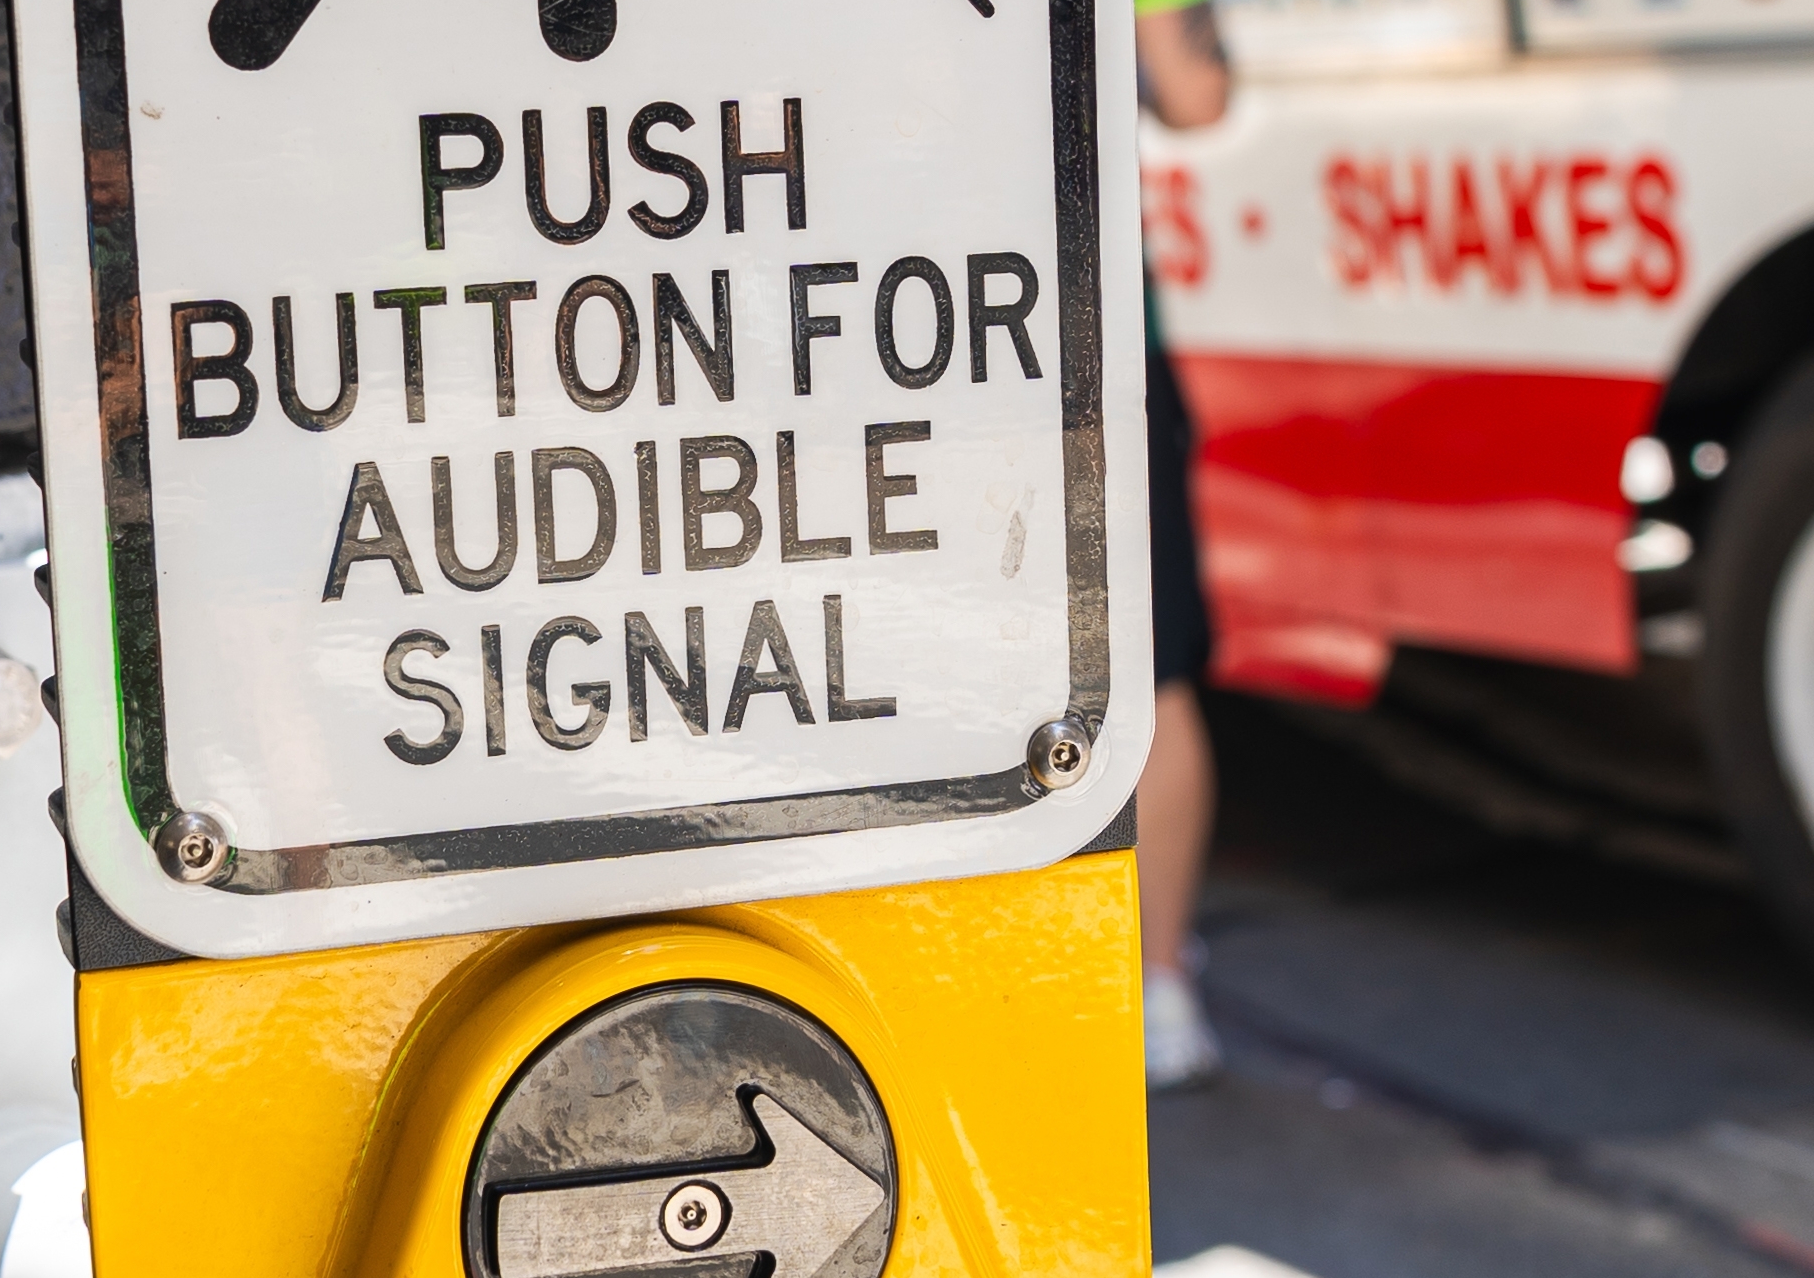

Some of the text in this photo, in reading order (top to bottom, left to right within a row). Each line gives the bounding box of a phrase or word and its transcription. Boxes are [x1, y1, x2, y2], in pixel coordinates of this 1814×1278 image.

[418, 97, 807, 251] PUSH
[1323, 153, 1689, 303] SHAKES
[170, 251, 1043, 440] BUTTON FOR
[321, 419, 939, 603] AUDIBLE
[382, 593, 898, 766] SIGNAL
